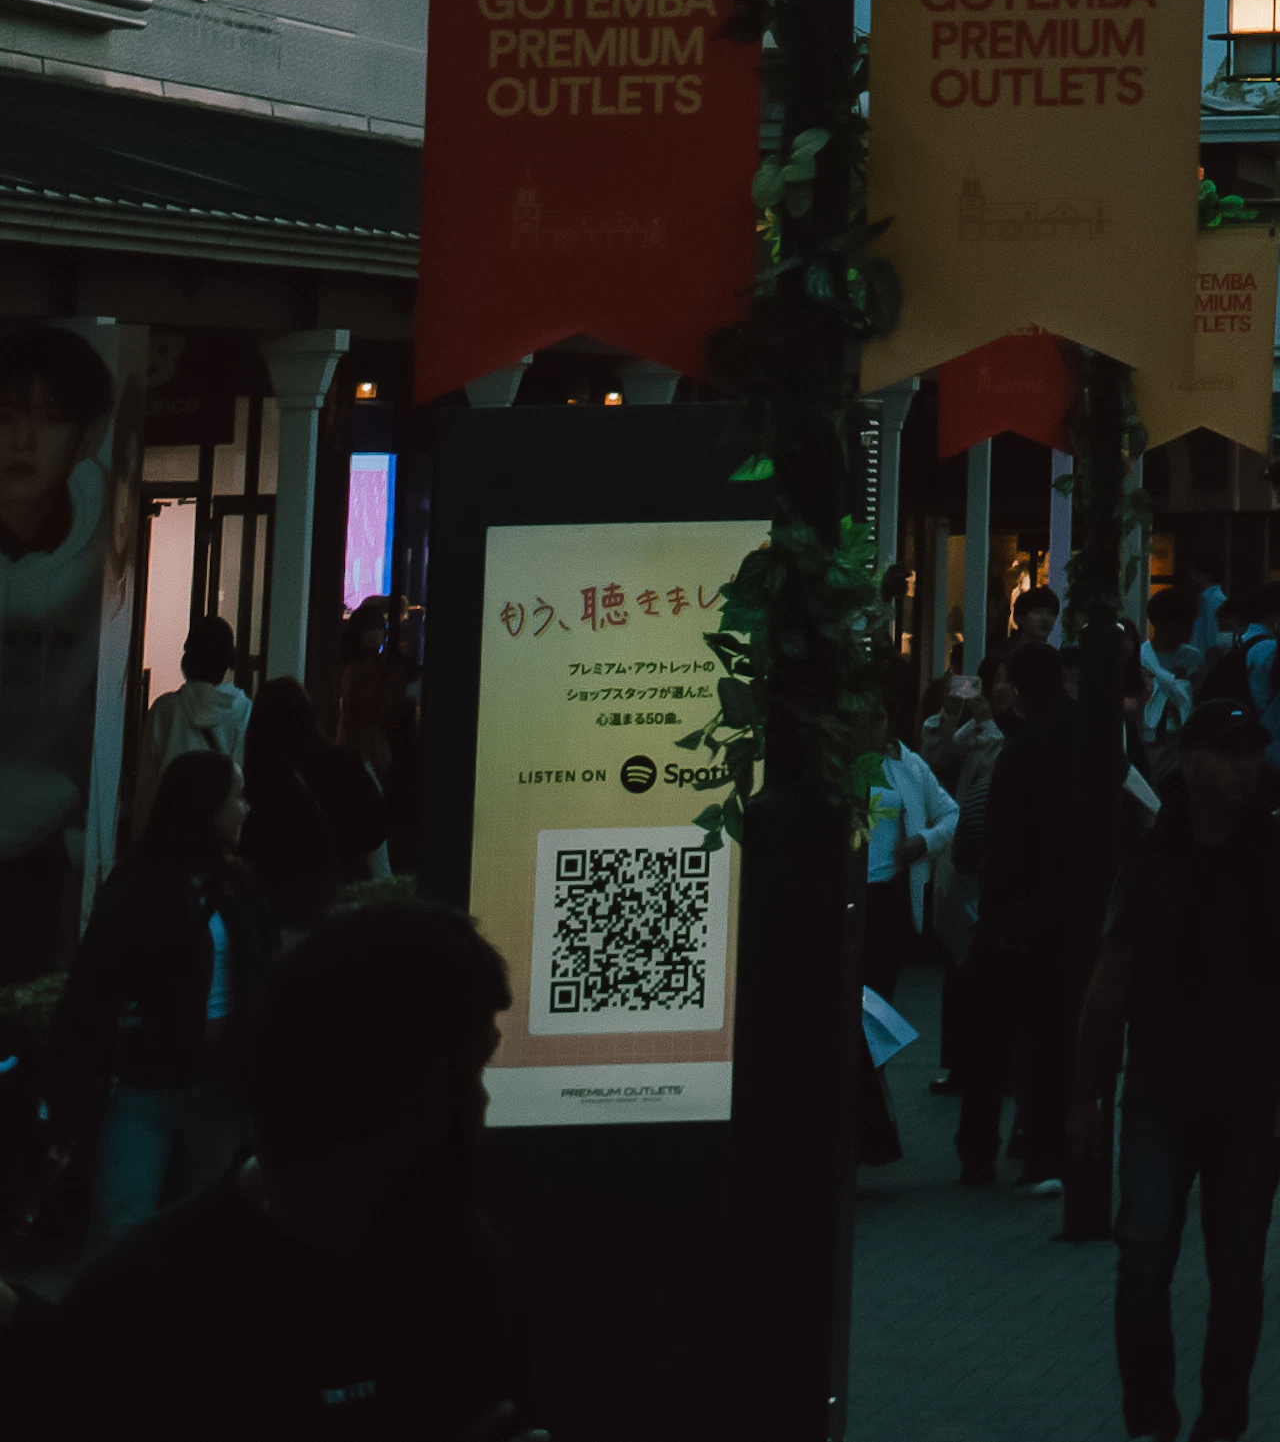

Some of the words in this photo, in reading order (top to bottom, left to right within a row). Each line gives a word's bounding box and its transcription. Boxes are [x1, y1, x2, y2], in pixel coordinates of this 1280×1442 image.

[489, 26, 704, 68] PREMIUM
[932, 18, 1145, 60] PREMIUM
[486, 75, 701, 117] OUTLETS
[930, 66, 1144, 109] OUTLETS
[501, 574, 735, 637] もう、聴きまし
[568, 660, 715, 676] プレミアム・アウトレットの
[518, 771, 576, 784] LISTEN
[582, 769, 607, 782] ON
